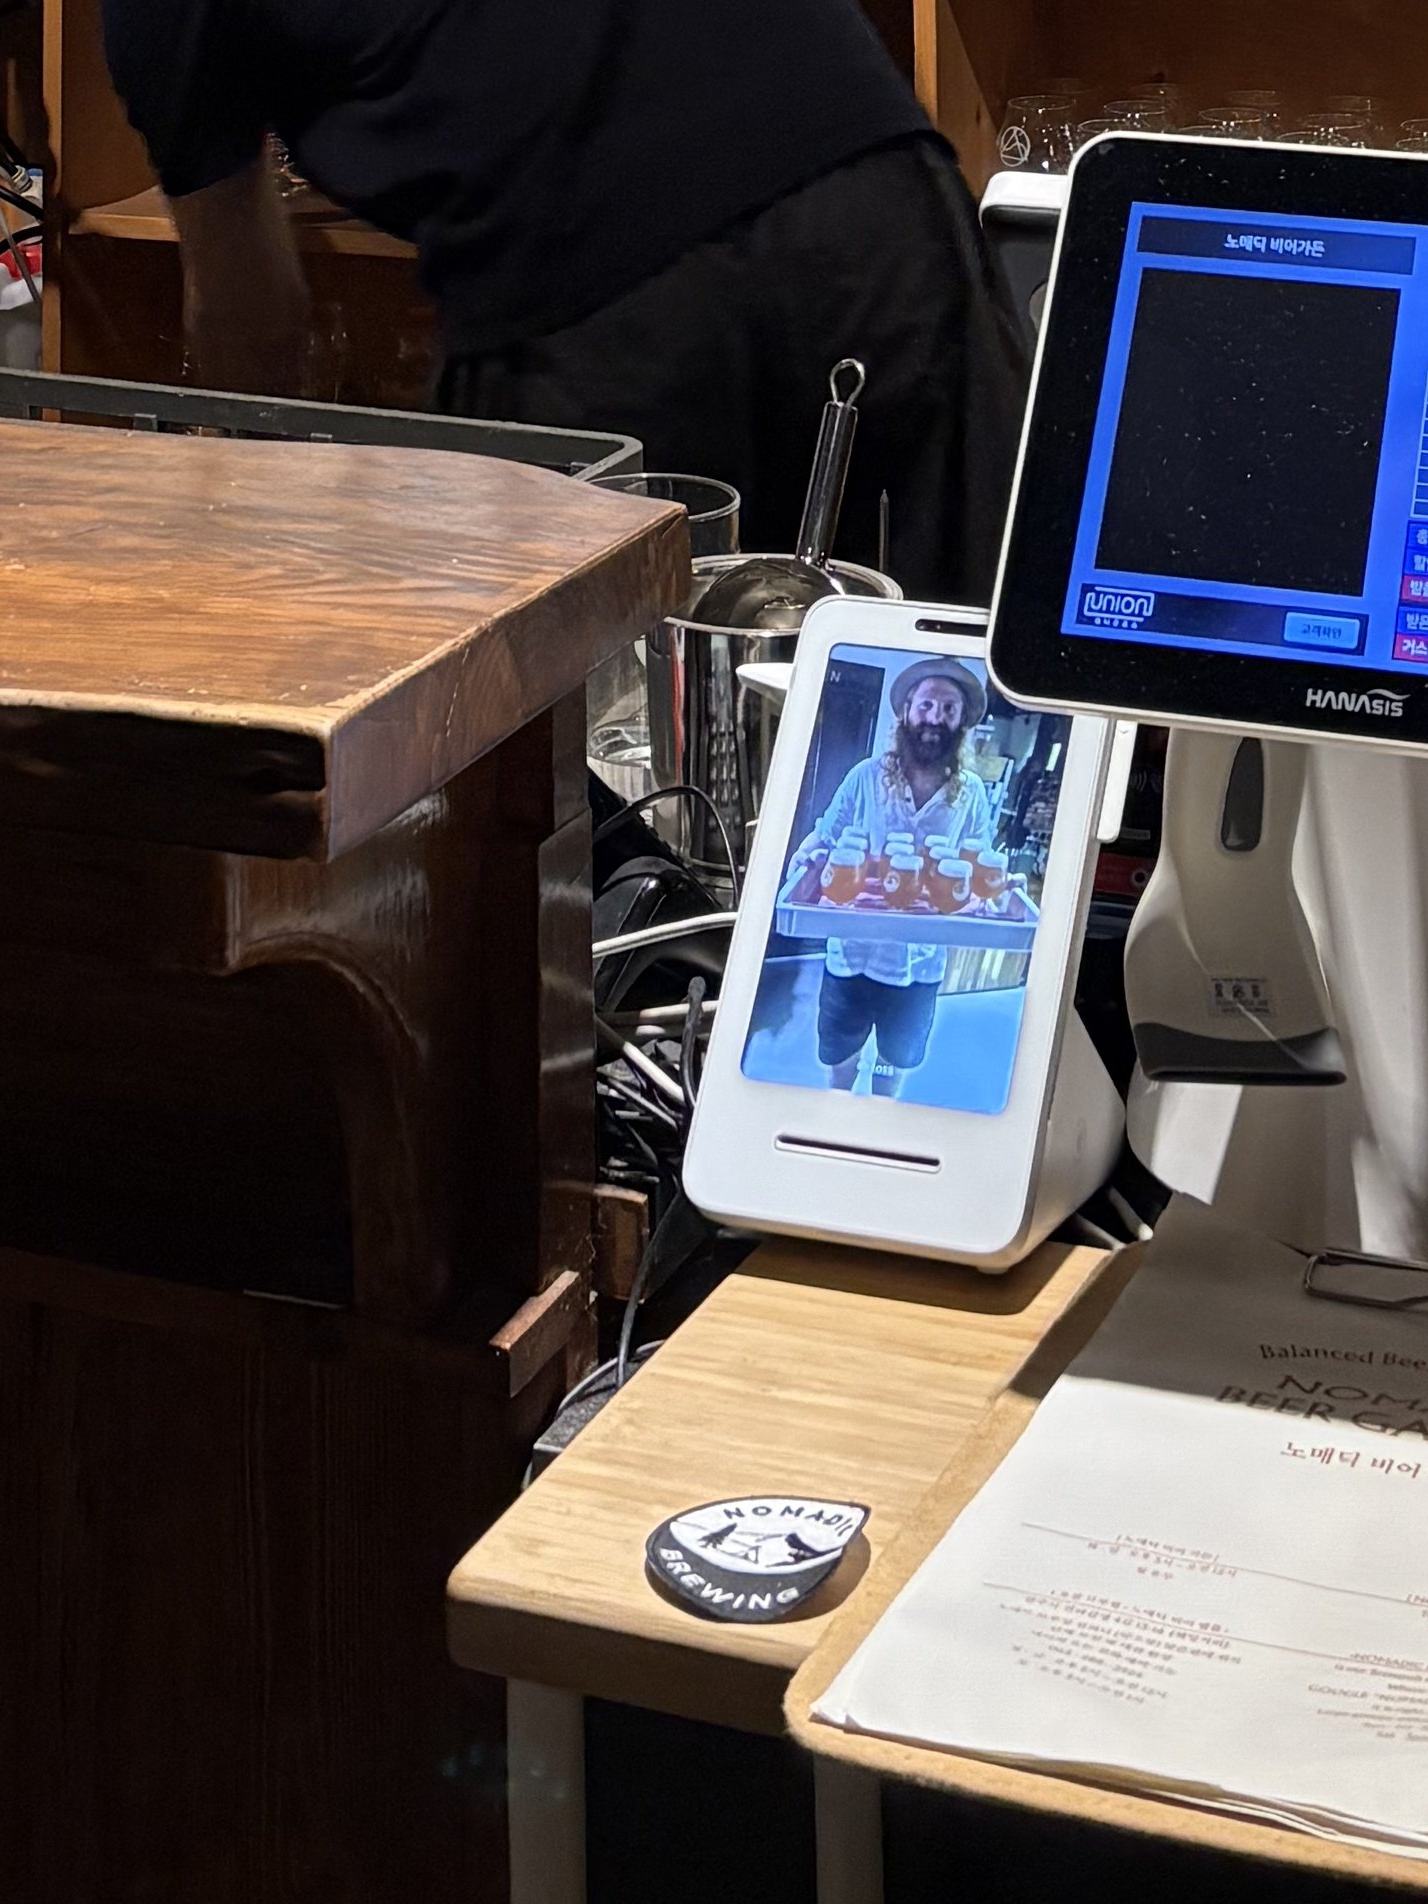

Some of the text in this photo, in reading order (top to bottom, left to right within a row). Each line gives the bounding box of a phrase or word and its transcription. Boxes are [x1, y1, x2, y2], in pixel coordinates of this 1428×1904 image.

[1086, 591, 1153, 617] UNION
[1306, 688, 1404, 717] HANASIS
[1259, 1344, 1374, 1365] Balanced
[1214, 1385, 1335, 1423] BEER
[1370, 1457, 1421, 1479] 비어
[723, 1505, 853, 1537] NOMADIC
[659, 1548, 800, 1610] BREWING
